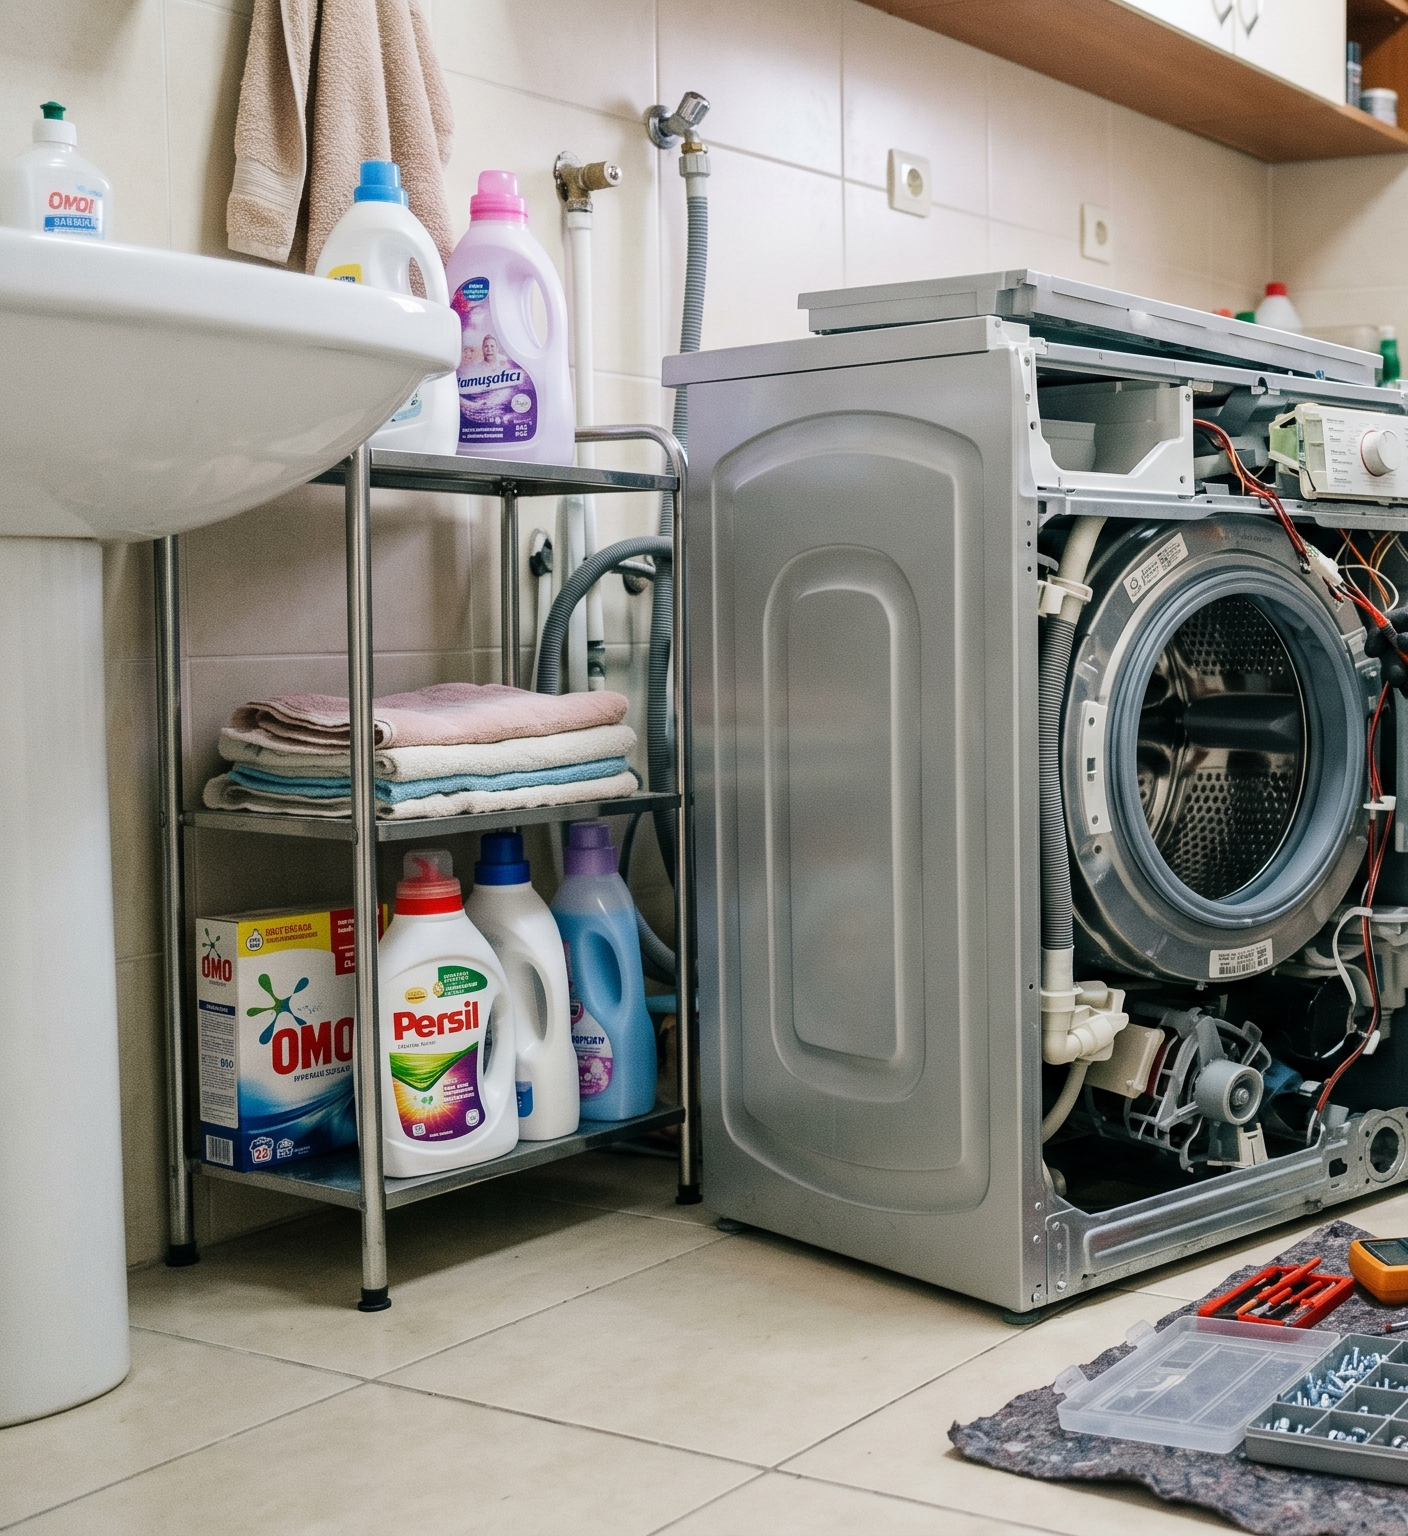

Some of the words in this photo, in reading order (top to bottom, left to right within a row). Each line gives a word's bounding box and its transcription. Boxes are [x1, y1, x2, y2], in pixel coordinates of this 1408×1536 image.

[201, 955, 232, 982] OMO
[393, 1000, 479, 1041] Persil
[272, 1017, 354, 1075] OMO
